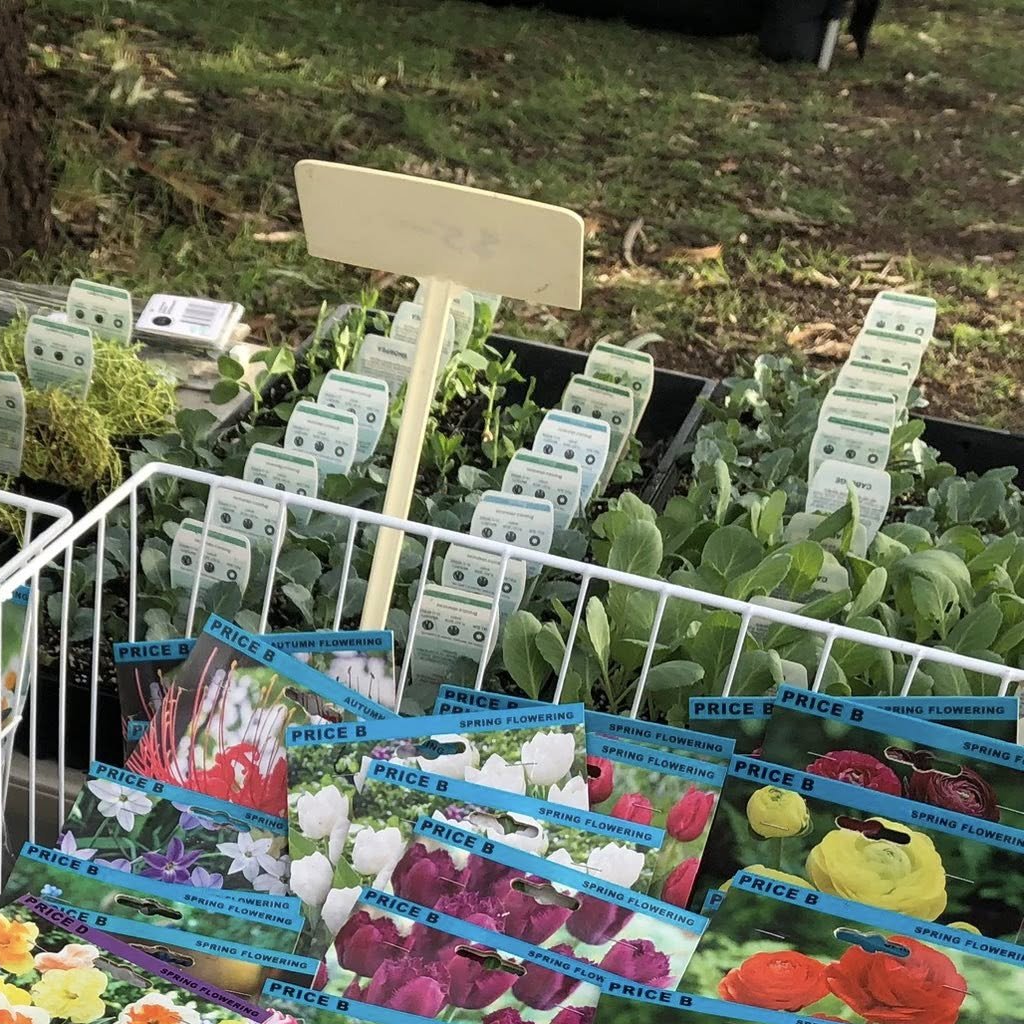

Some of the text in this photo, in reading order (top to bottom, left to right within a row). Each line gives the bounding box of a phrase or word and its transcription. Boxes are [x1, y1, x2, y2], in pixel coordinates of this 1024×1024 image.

[210, 620, 276, 662] PRICE B
[319, 638, 382, 648] FLOWERING
[96, 765, 165, 794] PRICE B
[734, 762, 815, 790] PRICE B
[244, 812, 284, 830] SPRING
[24, 896, 88, 934] PRICE D
[581, 880, 624, 902] SPRING
[625, 894, 696, 927] FLOWERING
[159, 967, 260, 1017] SPRING FLOWERING
[269, 982, 350, 1012] PRICE B
